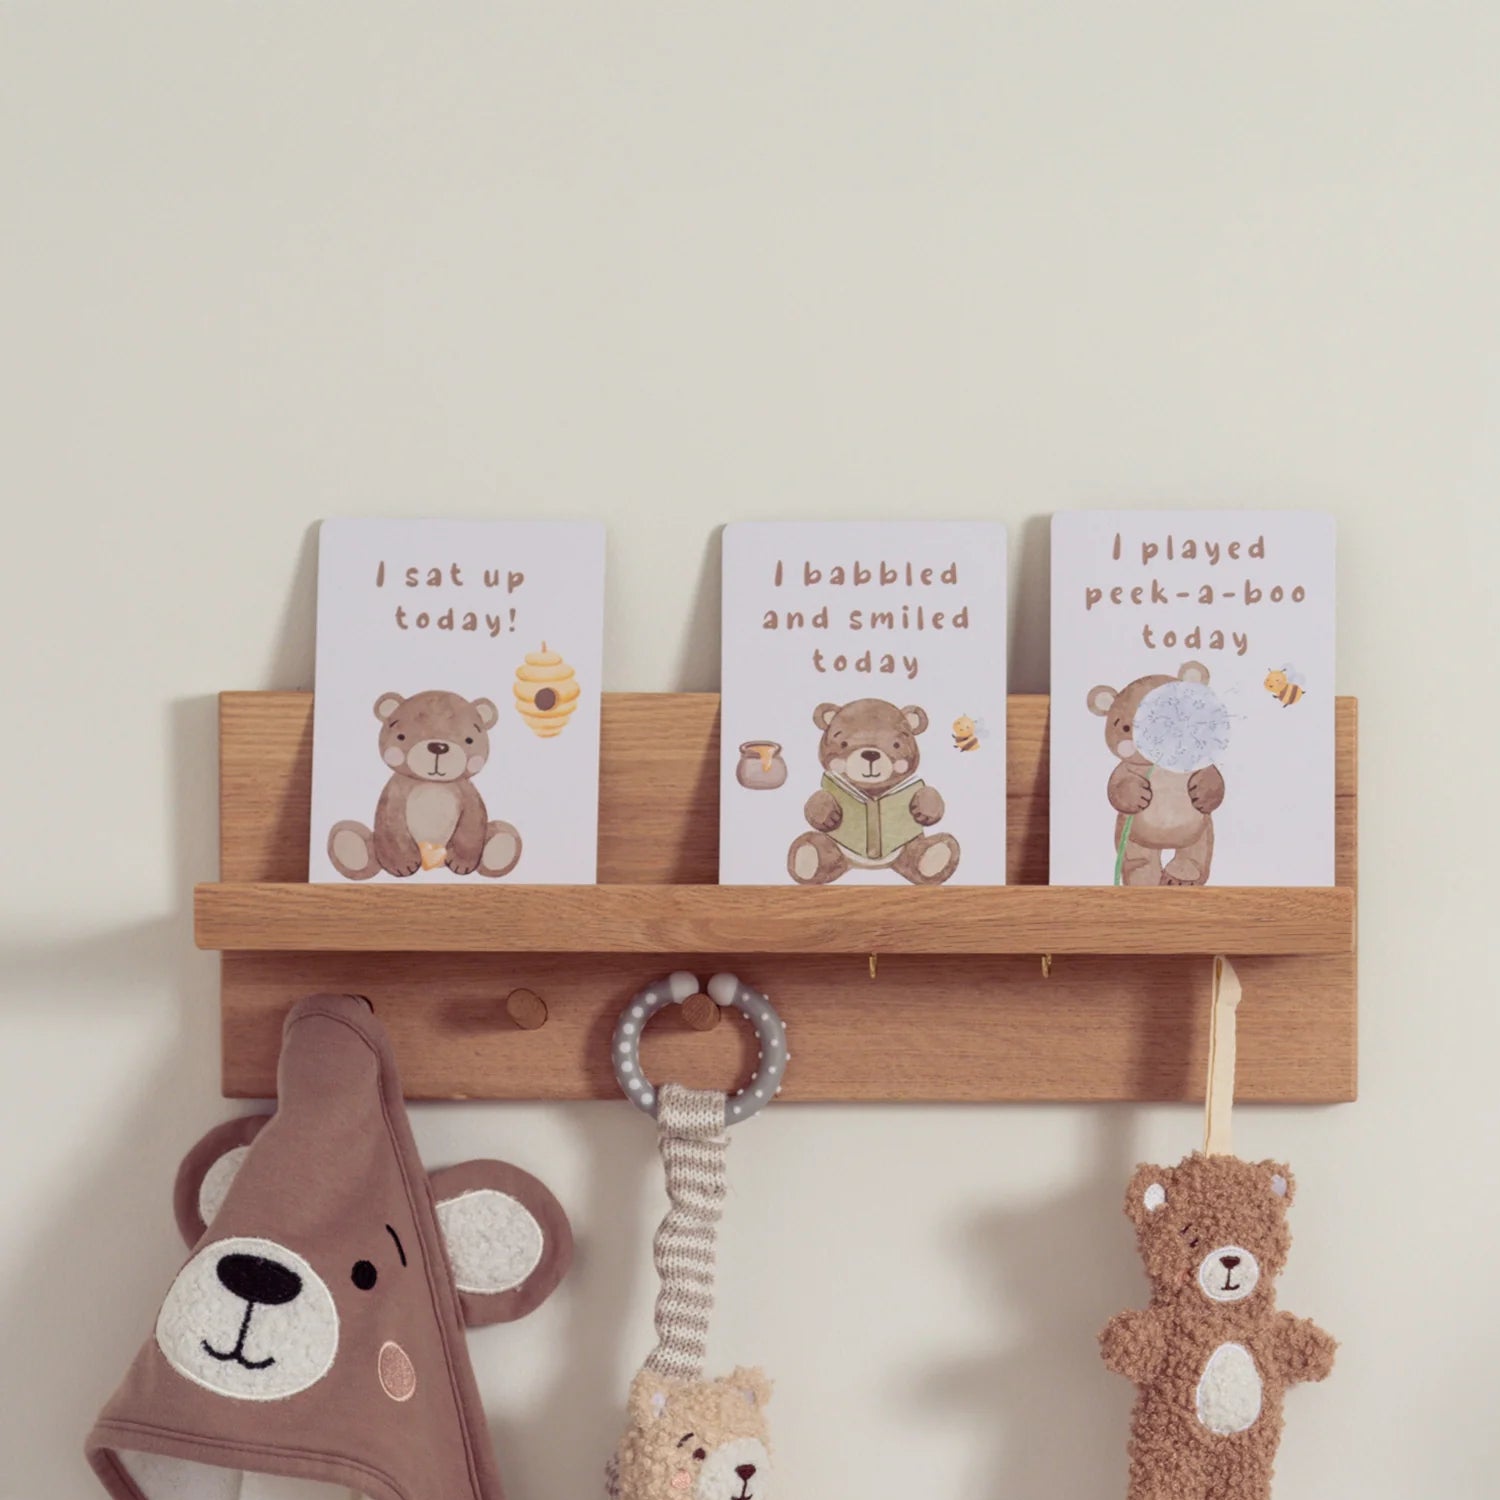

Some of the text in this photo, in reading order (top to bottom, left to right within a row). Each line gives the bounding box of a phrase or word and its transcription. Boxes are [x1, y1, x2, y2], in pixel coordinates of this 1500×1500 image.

[1112, 532, 1265, 566] I played
[375, 560, 525, 595] I sat up
[774, 559, 958, 587] I babbled
[1085, 578, 1306, 611] peek-a-boo
[394, 605, 517, 638] today!
[762, 604, 969, 631] and smiled
[1142, 623, 1248, 657] today
[812, 648, 919, 680] today
